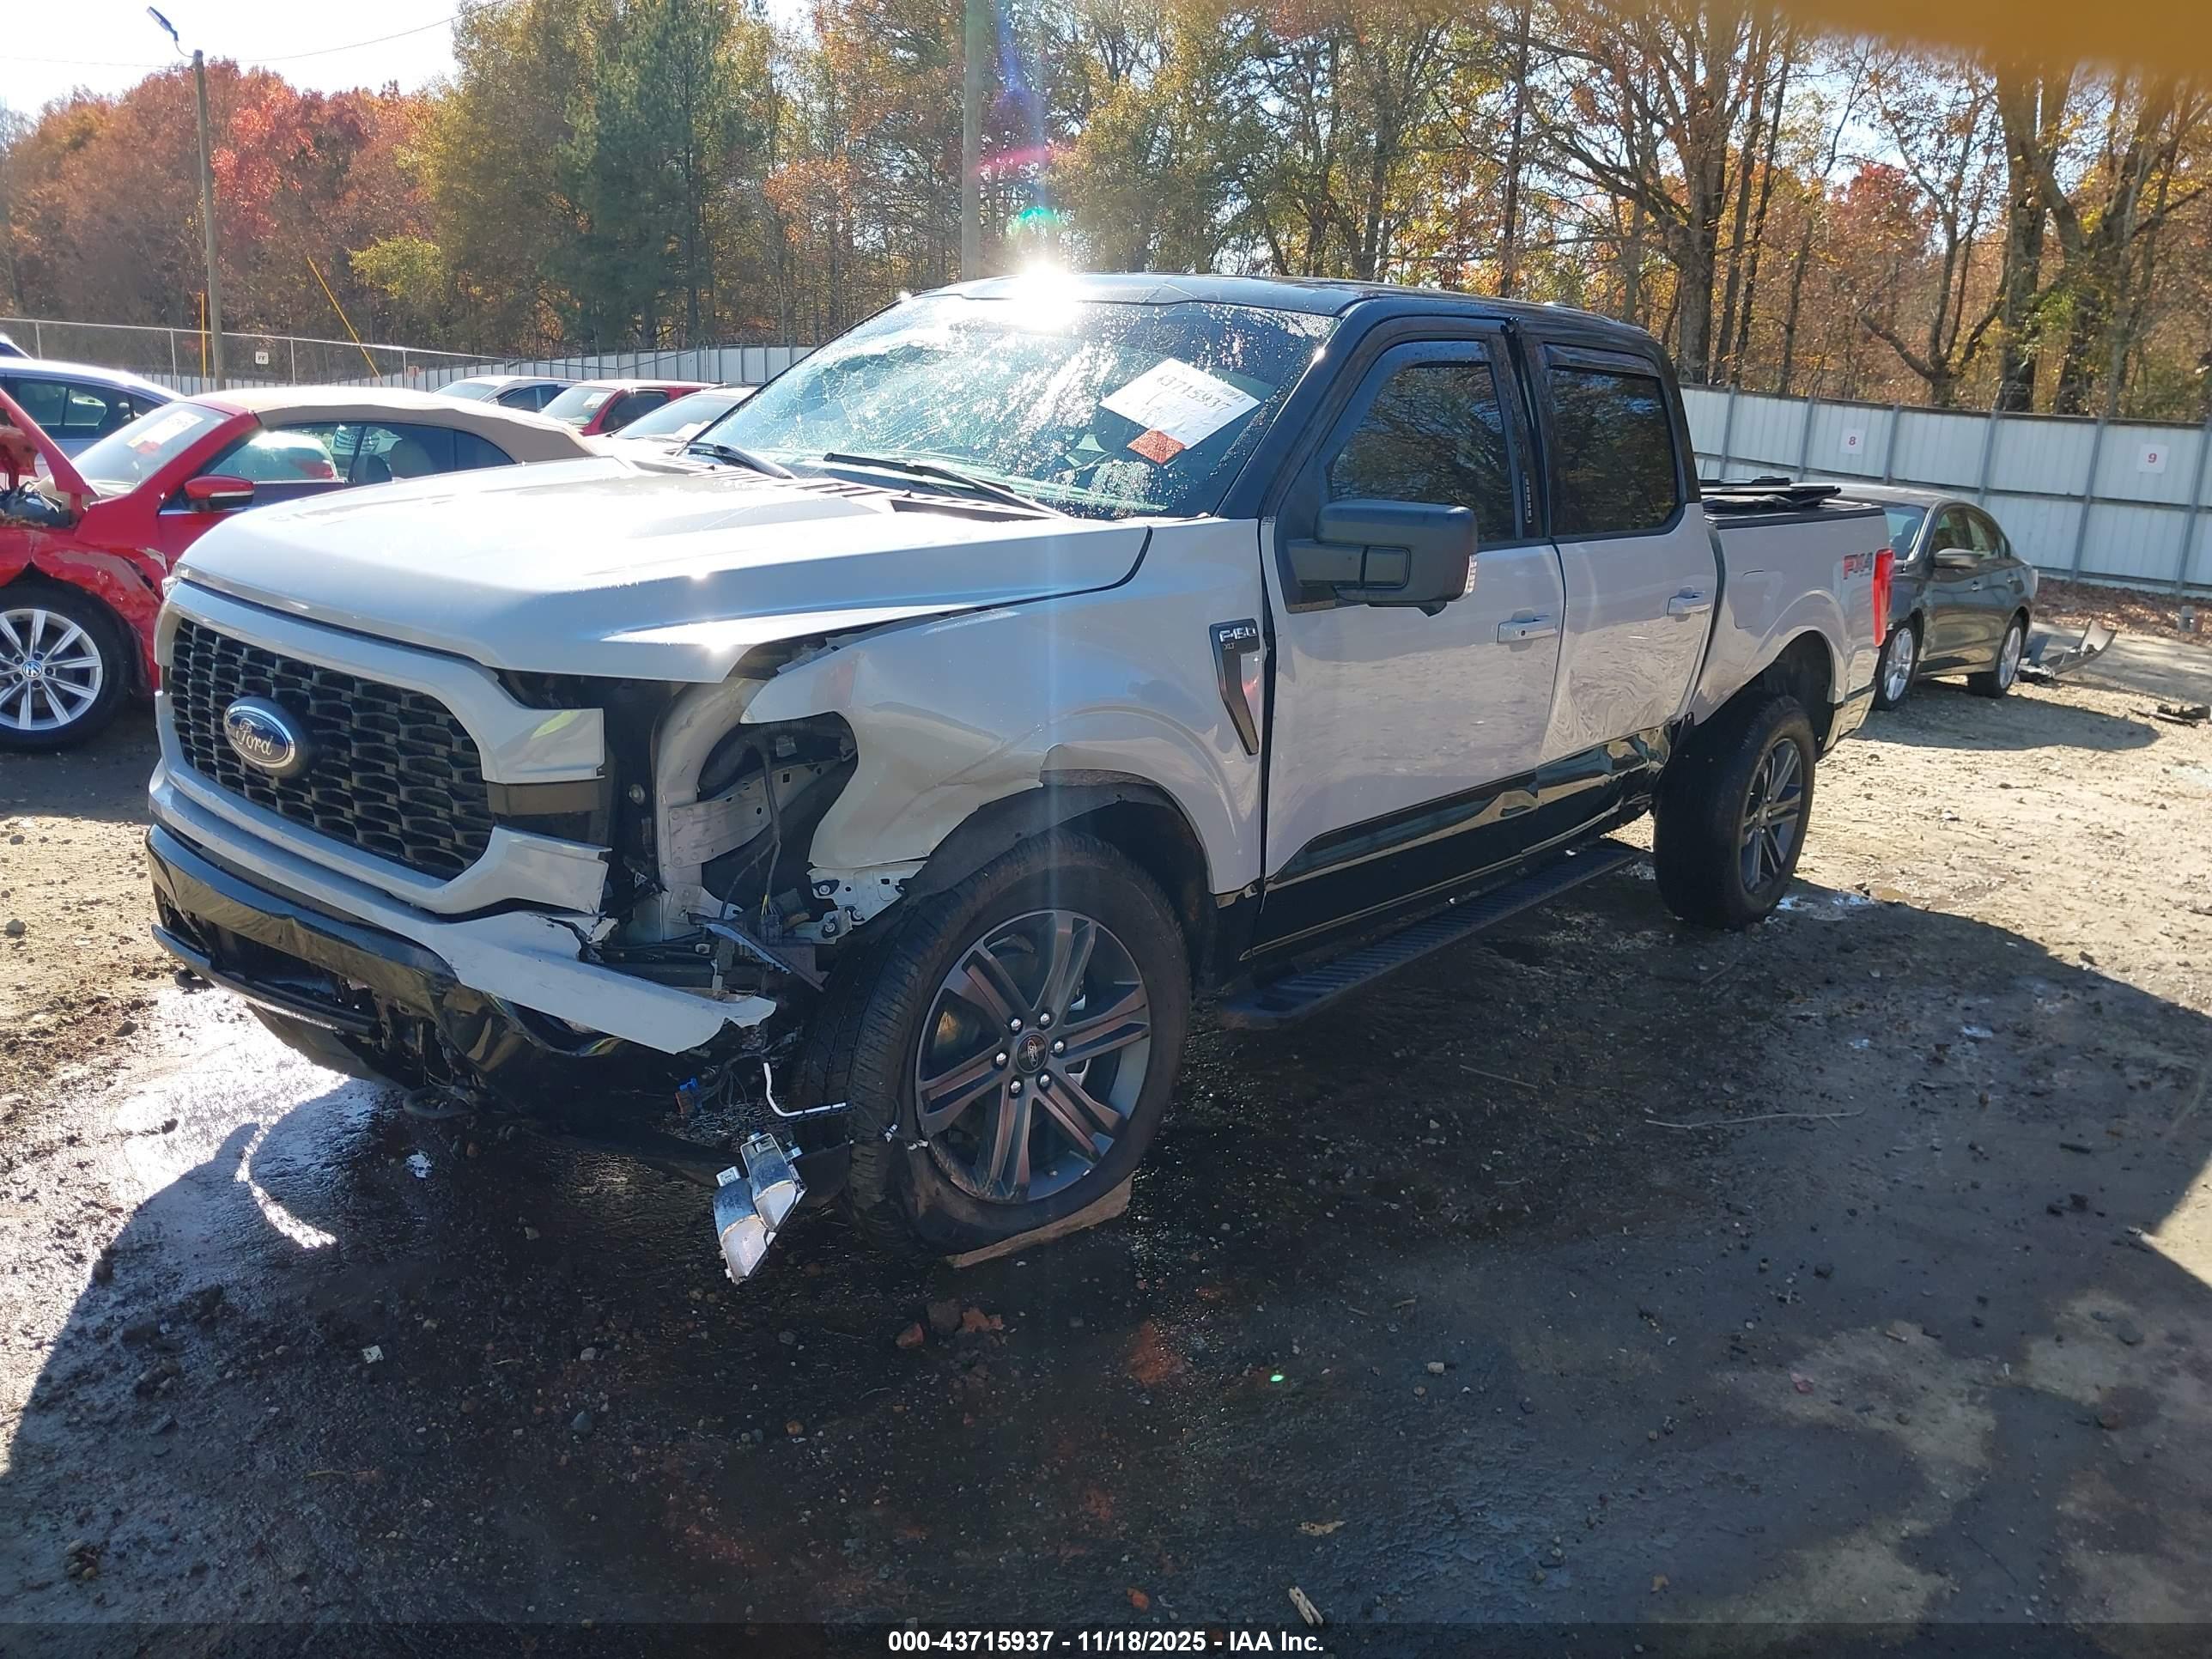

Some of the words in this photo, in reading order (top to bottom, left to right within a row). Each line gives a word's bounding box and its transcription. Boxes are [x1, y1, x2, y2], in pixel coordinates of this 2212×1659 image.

[1849, 436, 1856, 446] 8
[2148, 453, 2157, 463] 9
[235, 717, 274, 756] Ford
